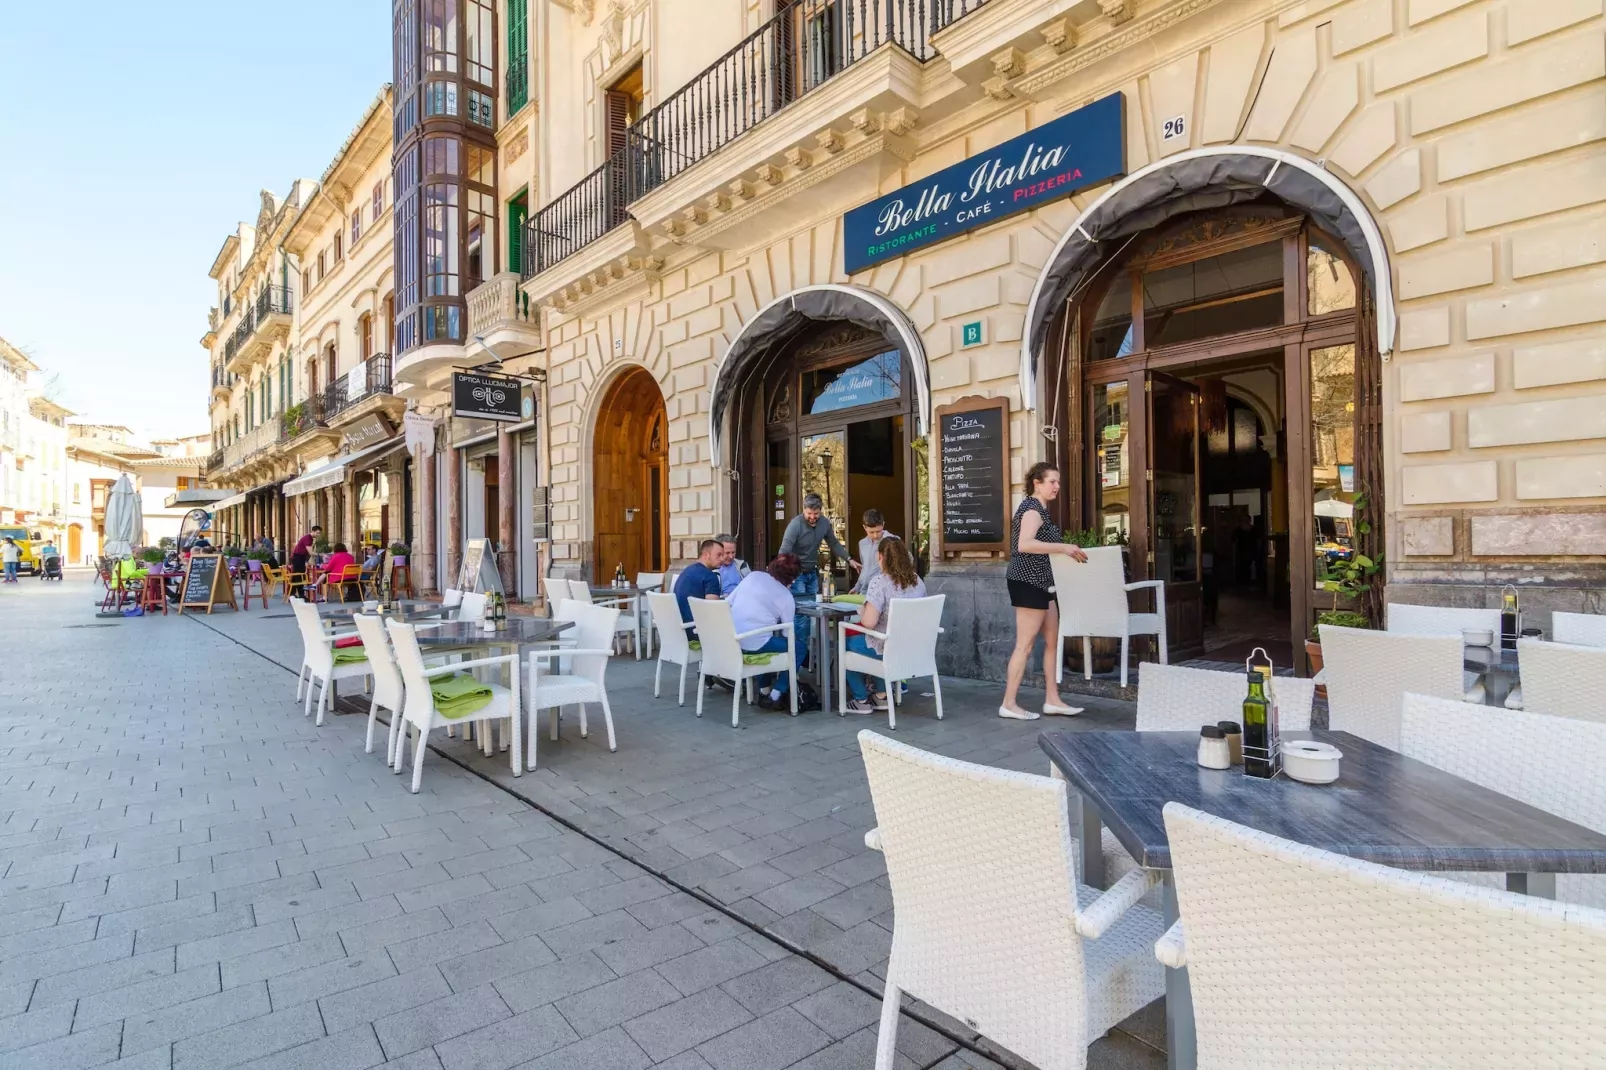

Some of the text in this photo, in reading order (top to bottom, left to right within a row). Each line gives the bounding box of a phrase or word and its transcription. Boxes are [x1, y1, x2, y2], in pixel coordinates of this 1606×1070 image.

[1164, 117, 1184, 139] 26
[875, 143, 1071, 236] Bella Italia
[868, 223, 937, 256] RISTORANTE
[956, 200, 992, 223] CAFÉ
[482, 379, 518, 389] LLUCMAJOR
[824, 376, 873, 395] Bella Italia
[952, 416, 979, 427] PIZZA
[943, 454, 973, 464] PROSCIUTTO
